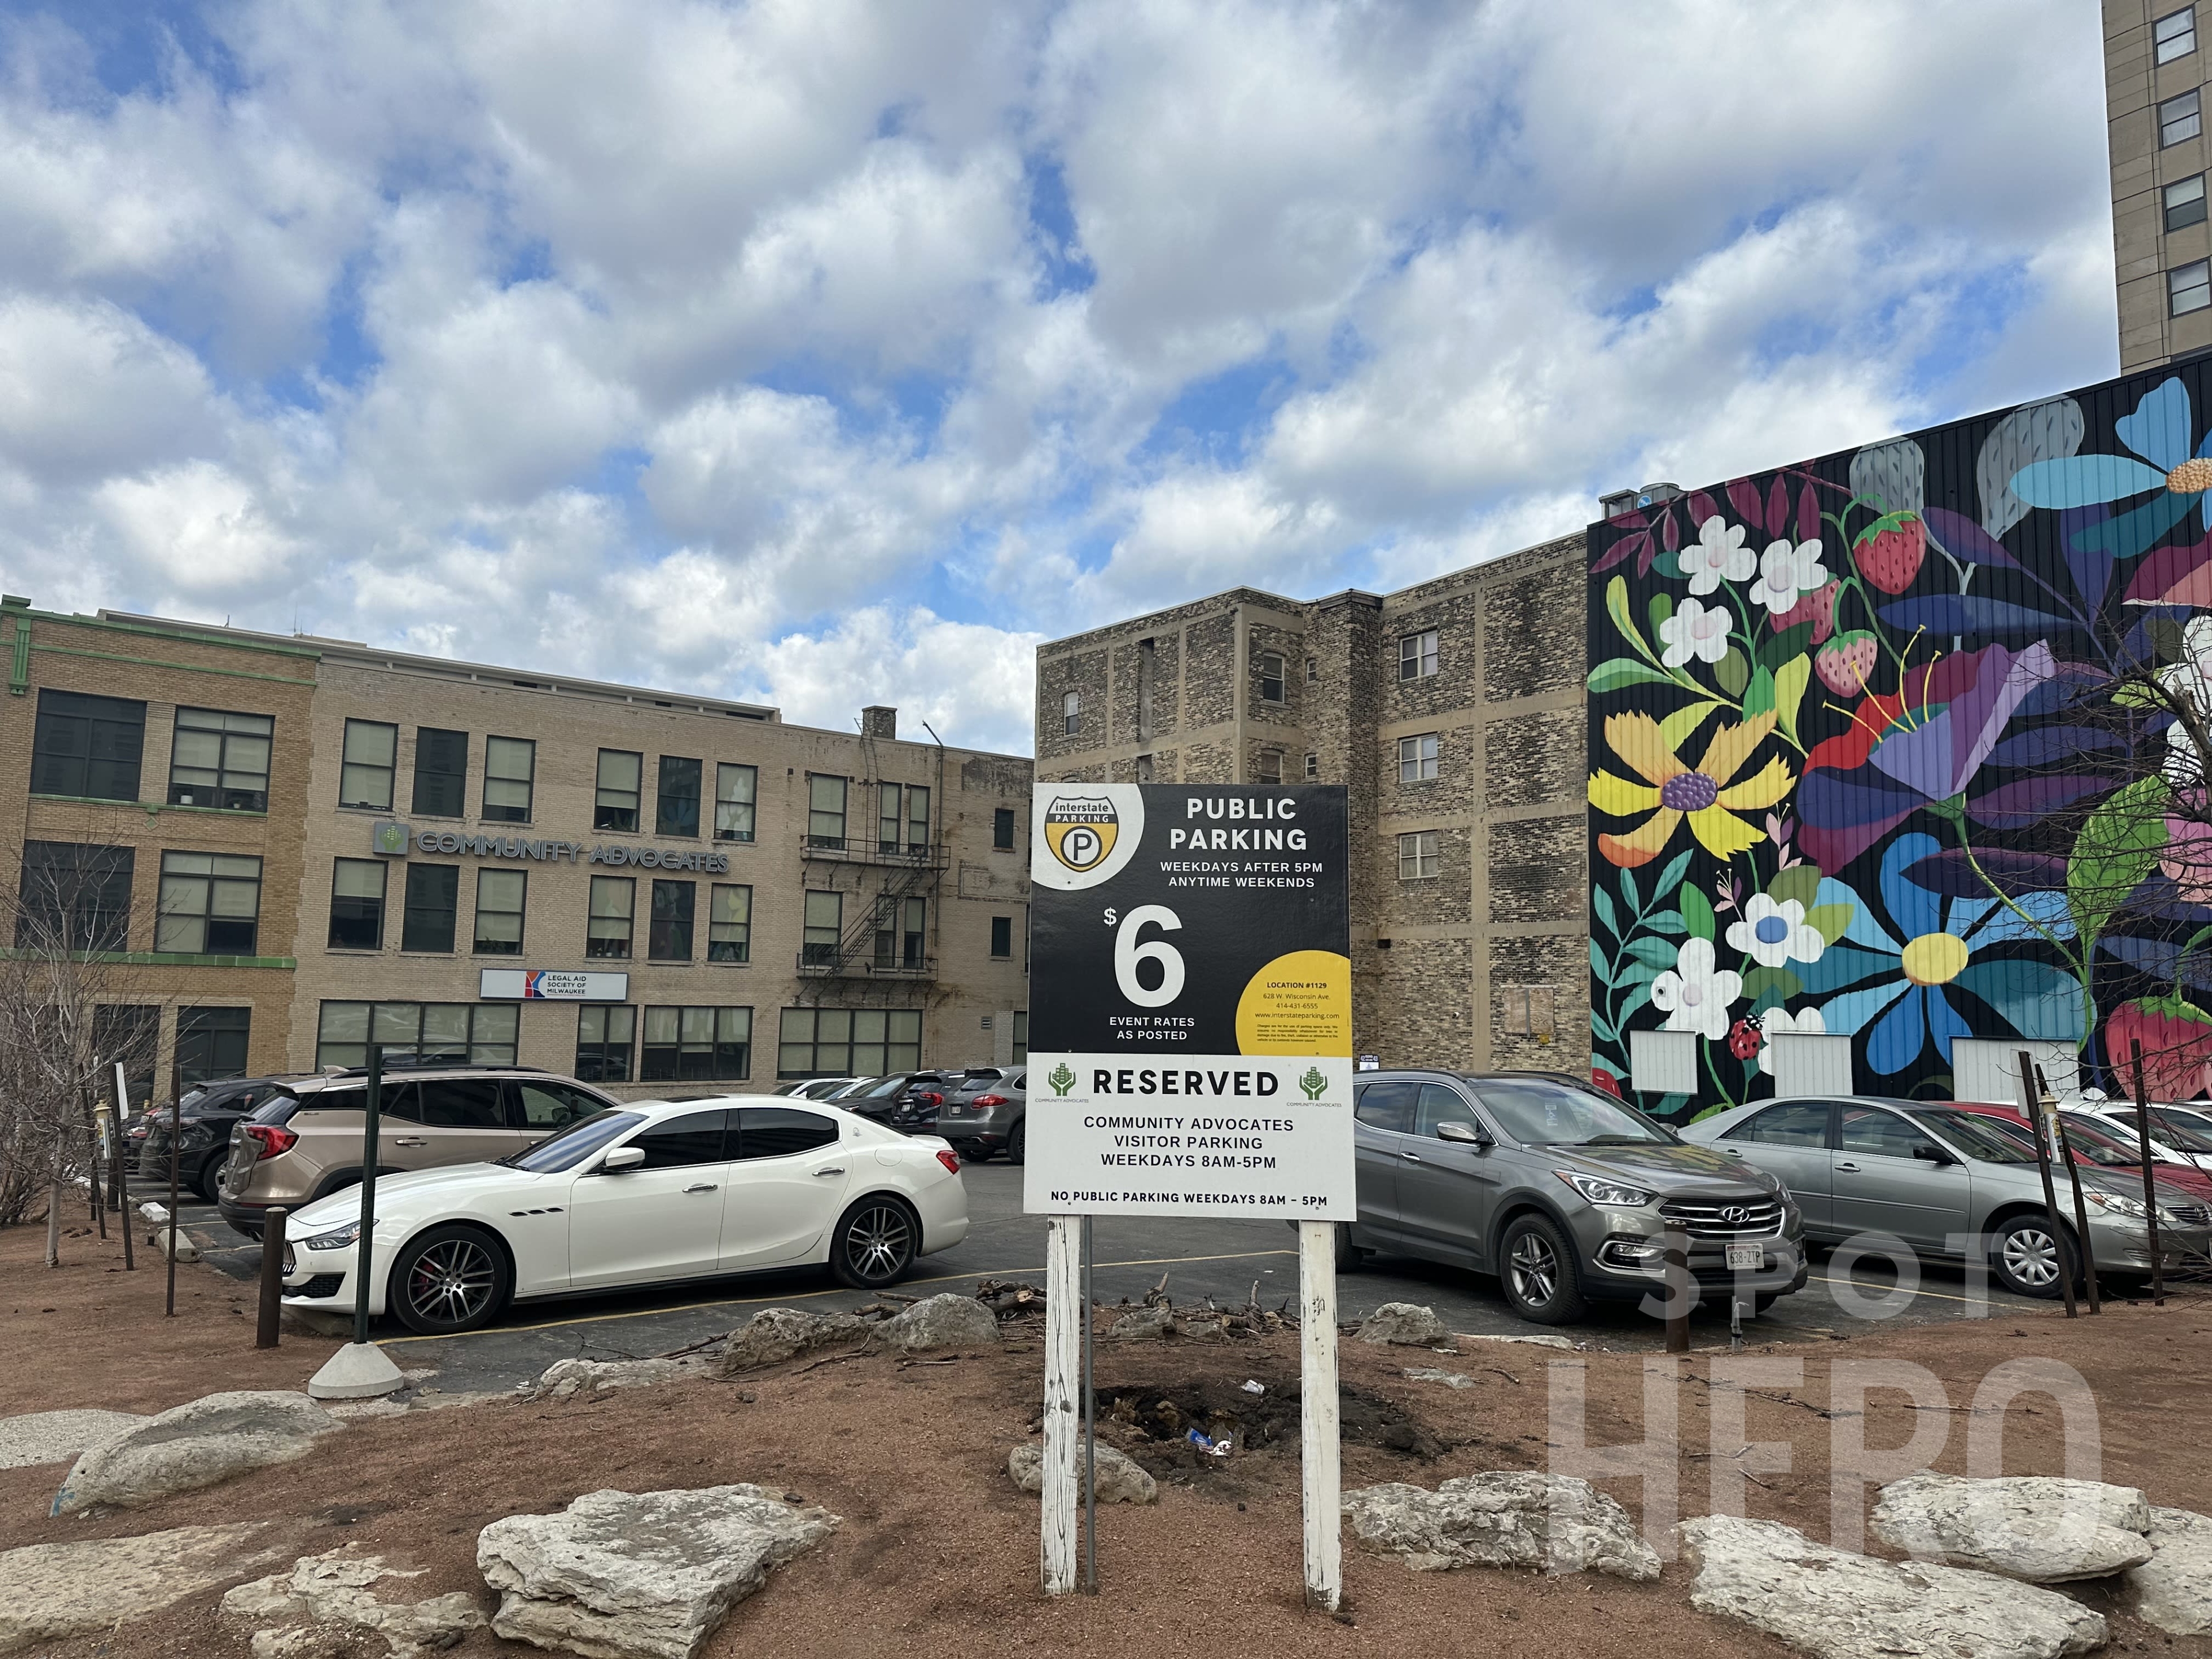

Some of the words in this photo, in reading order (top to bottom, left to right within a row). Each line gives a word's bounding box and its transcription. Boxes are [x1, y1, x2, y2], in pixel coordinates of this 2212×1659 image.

[1055, 802, 1109, 812] interstate
[1187, 798, 1296, 820] PUBLIC
[1055, 815, 1109, 823] PARKING
[1171, 828, 1306, 850] PARKING
[416, 831, 581, 862] COMMUNITY
[590, 844, 729, 873] ADVOCATES
[1073, 834, 1092, 861] P
[1160, 861, 1239, 872] WEEKDAYS
[1244, 862, 1290, 872] AFTER
[1294, 862, 1323, 873] 5PM
[1168, 877, 1230, 887] ANYTIME
[1235, 877, 1315, 888] WEEKENDS
[1109, 1017, 1150, 1026] EVENT
[1154, 1017, 1195, 1027] RATES
[1116, 1030, 1133, 1039] AS
[1138, 1031, 1187, 1040] POSTED
[1093, 1069, 1278, 1096] RESERVED
[1084, 1116, 1184, 1129] COMMUNITY
[1191, 1118, 1293, 1131] ADVOCATES
[1114, 1135, 1180, 1148] VISITOR
[1187, 1136, 1263, 1149] PARKING
[1101, 1154, 1195, 1167] WEEKDAYS
[1202, 1155, 1276, 1169] 8AM-5PM
[1051, 1191, 1069, 1200] NO
[1073, 1191, 1118, 1202] PUBLIC
[1123, 1192, 1179, 1203] PARKING
[1183, 1193, 1255, 1205] WEEKDAYS
[1260, 1195, 1286, 1205] 8AM
[1302, 1196, 1327, 1206] 5PM
[1730, 1251, 1760, 1264] 638-ZTP
